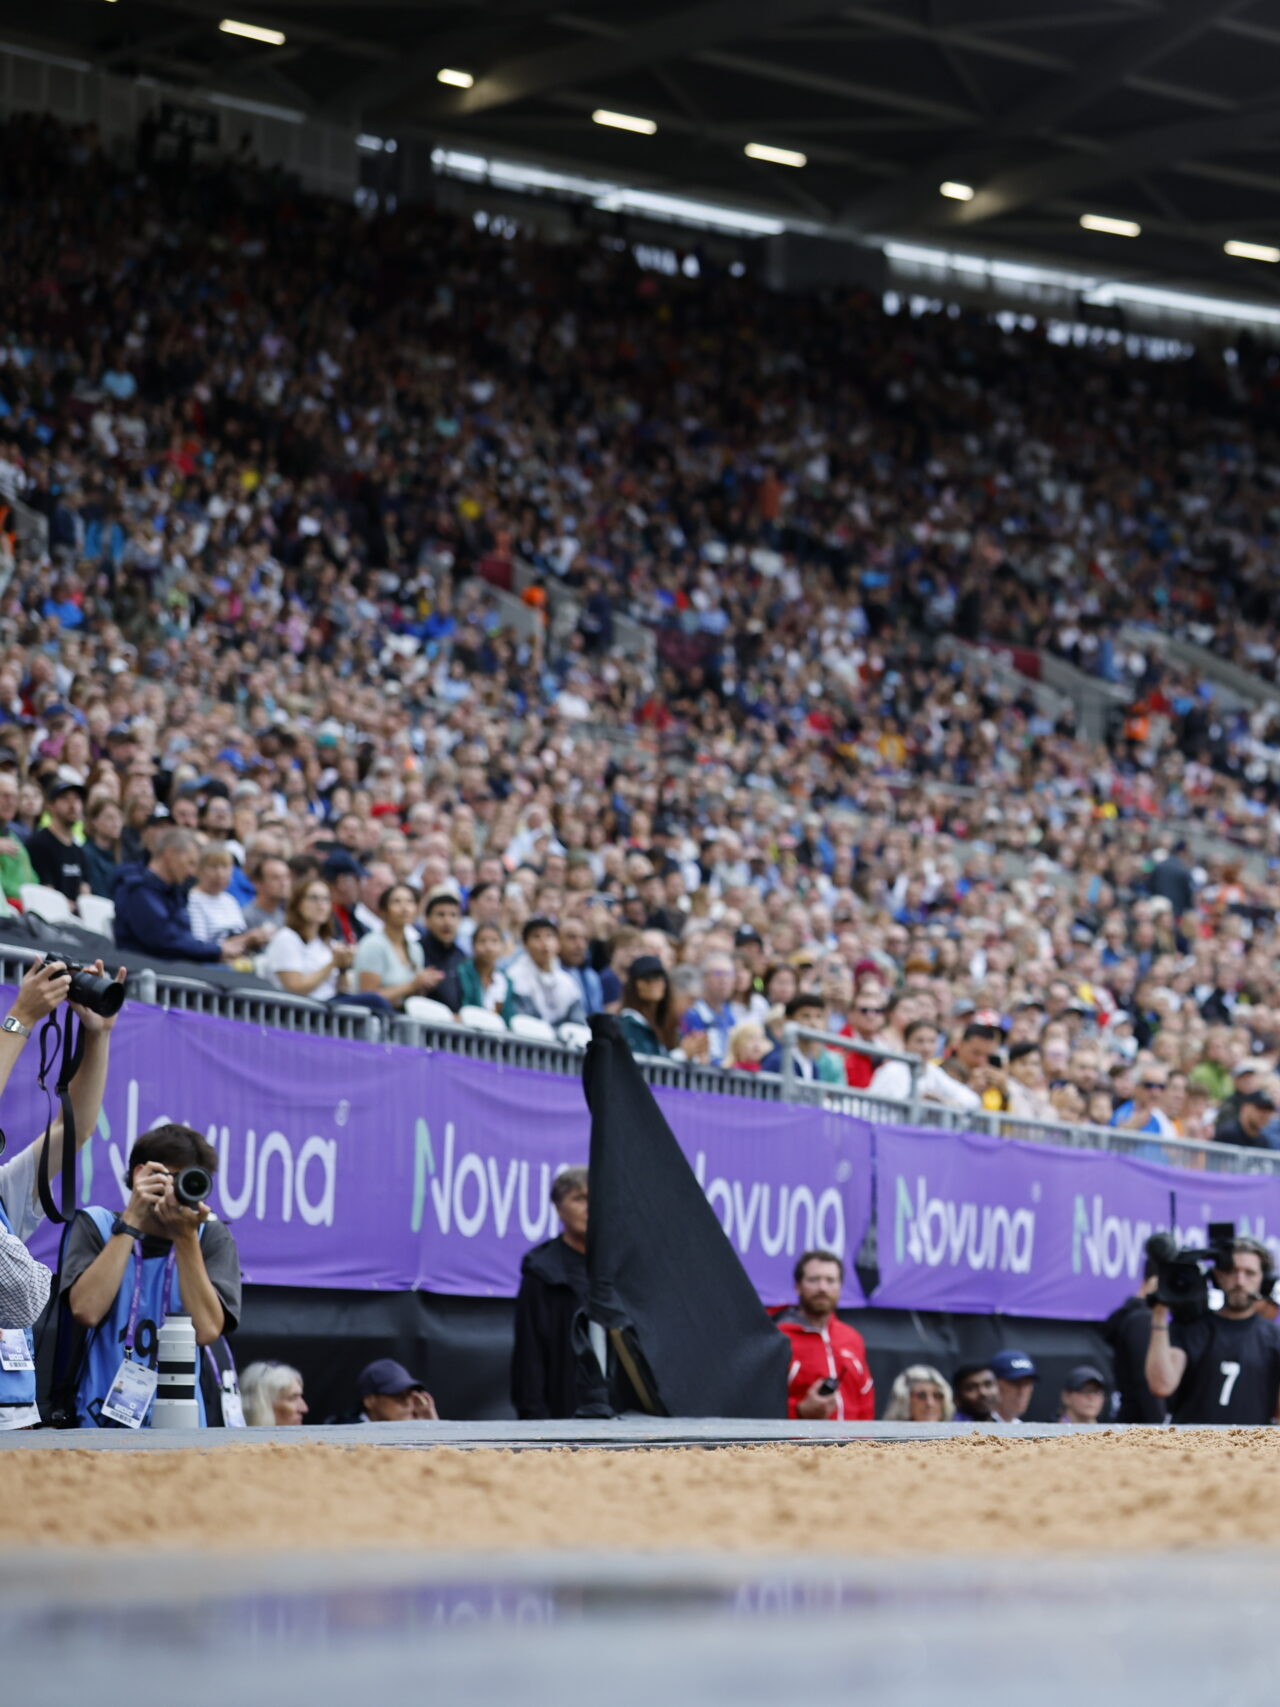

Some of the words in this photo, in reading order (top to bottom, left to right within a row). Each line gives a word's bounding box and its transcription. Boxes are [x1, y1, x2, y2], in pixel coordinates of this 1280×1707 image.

[82, 1078, 337, 1228] Nuna
[411, 1117, 572, 1242] Novu
[695, 1151, 846, 1262] ovuna
[895, 1174, 1036, 1275] Novuna
[1219, 1360, 1241, 1406] 7
